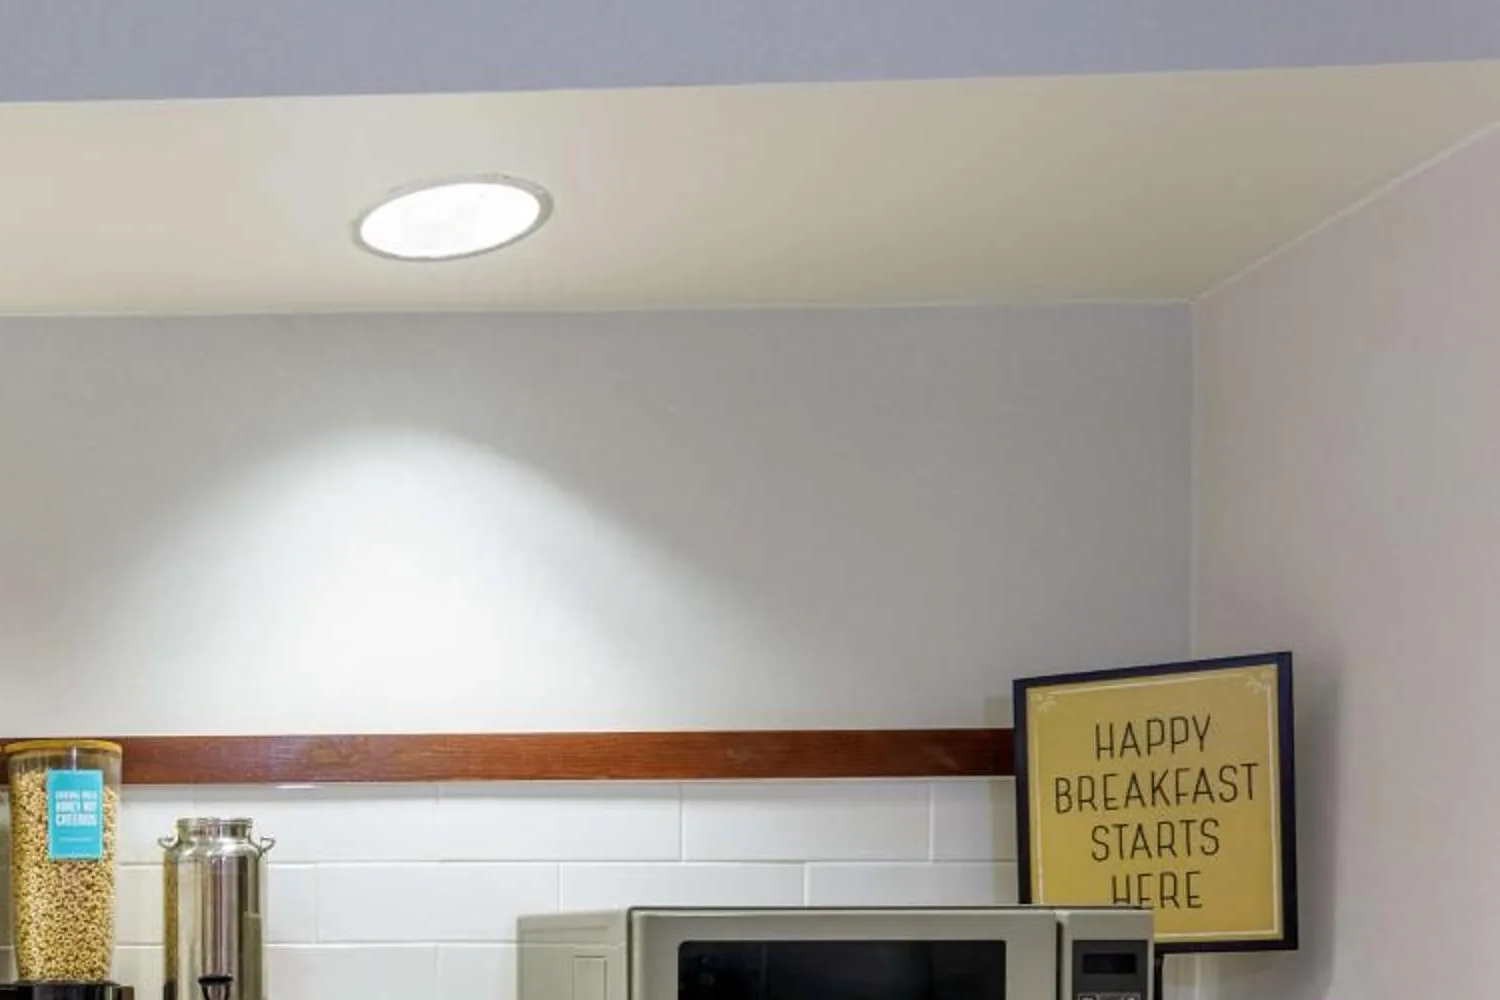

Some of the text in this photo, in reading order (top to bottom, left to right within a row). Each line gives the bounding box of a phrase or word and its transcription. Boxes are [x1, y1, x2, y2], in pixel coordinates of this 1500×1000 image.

[1095, 714, 1211, 761] HAPPY
[1054, 762, 1259, 814] BREAKFAST
[1090, 818, 1220, 863] STARTS
[1111, 870, 1203, 909] HERE
